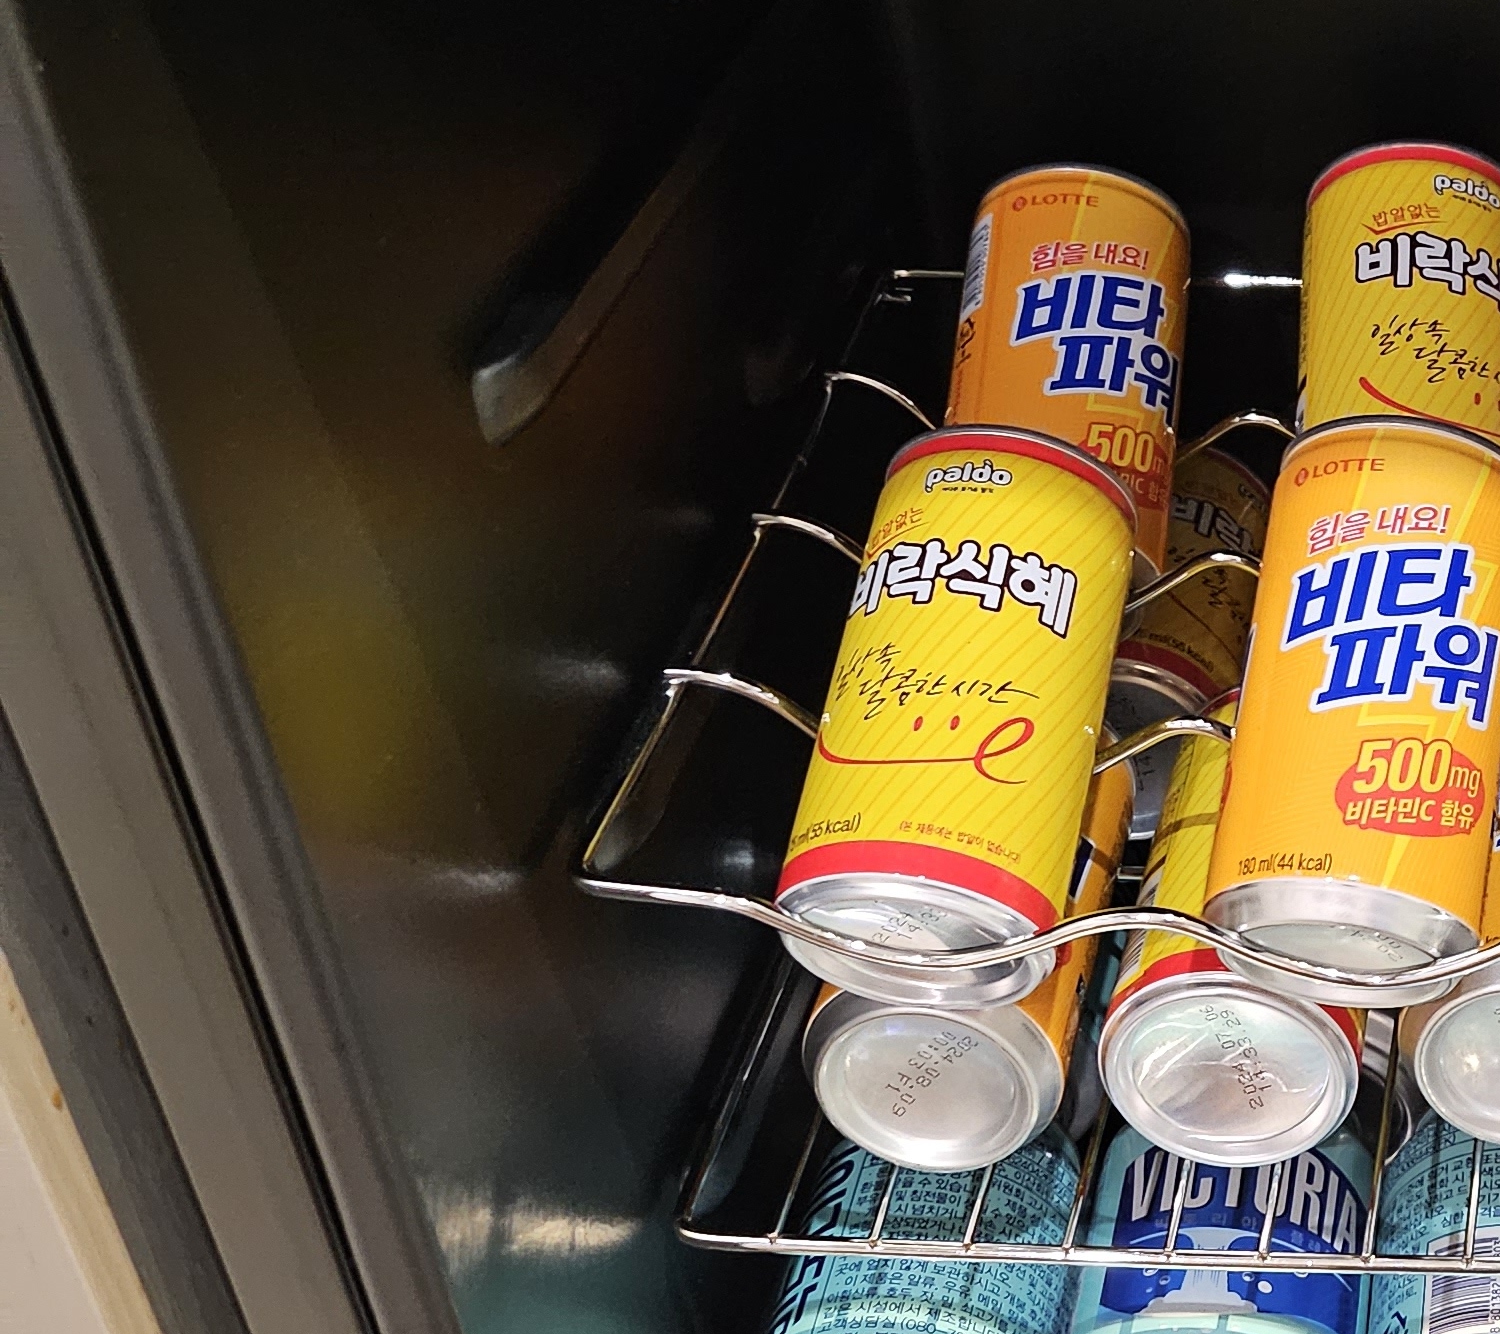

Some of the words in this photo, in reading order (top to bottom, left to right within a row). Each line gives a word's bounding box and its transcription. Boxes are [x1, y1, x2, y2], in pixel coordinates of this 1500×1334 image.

[1031, 192, 1100, 208] LOTTE
[1372, 202, 1441, 227] 밥알없는
[1031, 241, 1088, 273] 힘을
[1094, 241, 1150, 270] 내요!
[1011, 272, 1167, 344] 비타
[1048, 334, 1180, 428] 파워
[1413, 341, 1491, 383] 달콤한
[925, 459, 1013, 494] paldo
[1312, 458, 1386, 479] LOTTE
[1309, 510, 1371, 555] 힘을
[1377, 506, 1451, 535] 내요!
[849, 538, 1078, 639] 비락식혜
[1284, 547, 1473, 645] 비타
[875, 642, 902, 670] 속
[1316, 623, 1499, 723] 파워
[860, 667, 949, 721] 달콤한
[951, 680, 1041, 705] 시간
[1351, 739, 1482, 799] 500mg
[824, 812, 862, 834] kcal)
[1345, 797, 1436, 825] 비타민C
[1440, 800, 1475, 830] 함유
[1131, 1149, 1358, 1255] VICTORIA
[817, 1315, 898, 1334] 고객상담실
[855, 1301, 923, 1318] 시설에서
